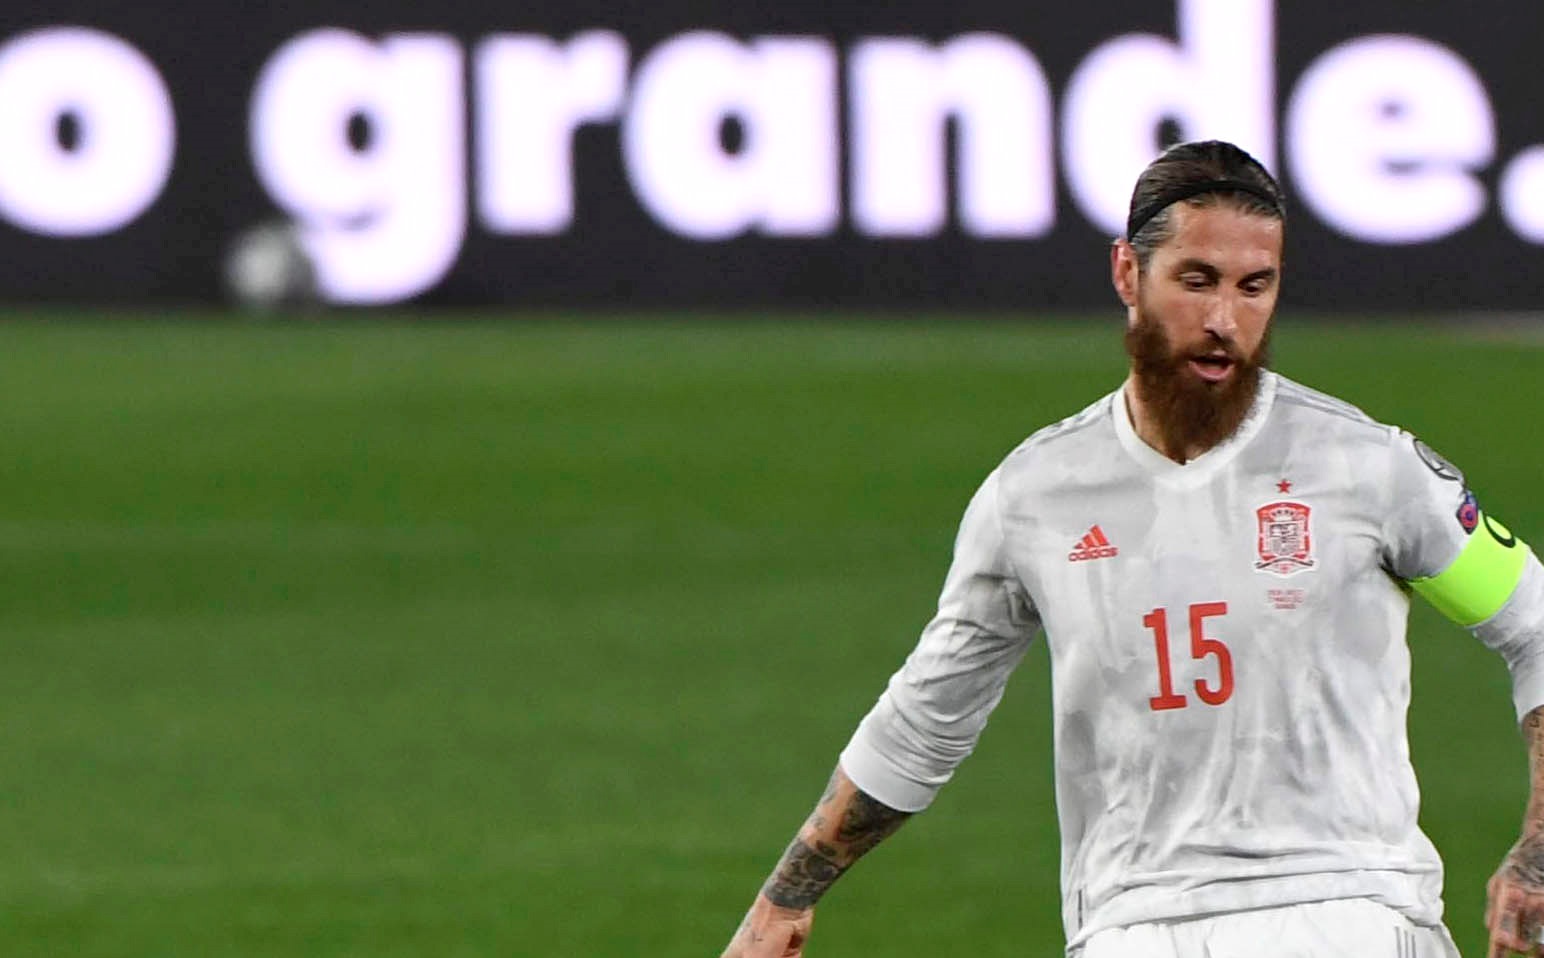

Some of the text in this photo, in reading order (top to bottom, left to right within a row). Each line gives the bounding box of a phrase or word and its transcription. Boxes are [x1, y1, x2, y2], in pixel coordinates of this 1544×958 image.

[0, 28, 174, 236] o
[1068, 547, 1118, 562] adidas
[1142, 602, 1236, 712] 15
